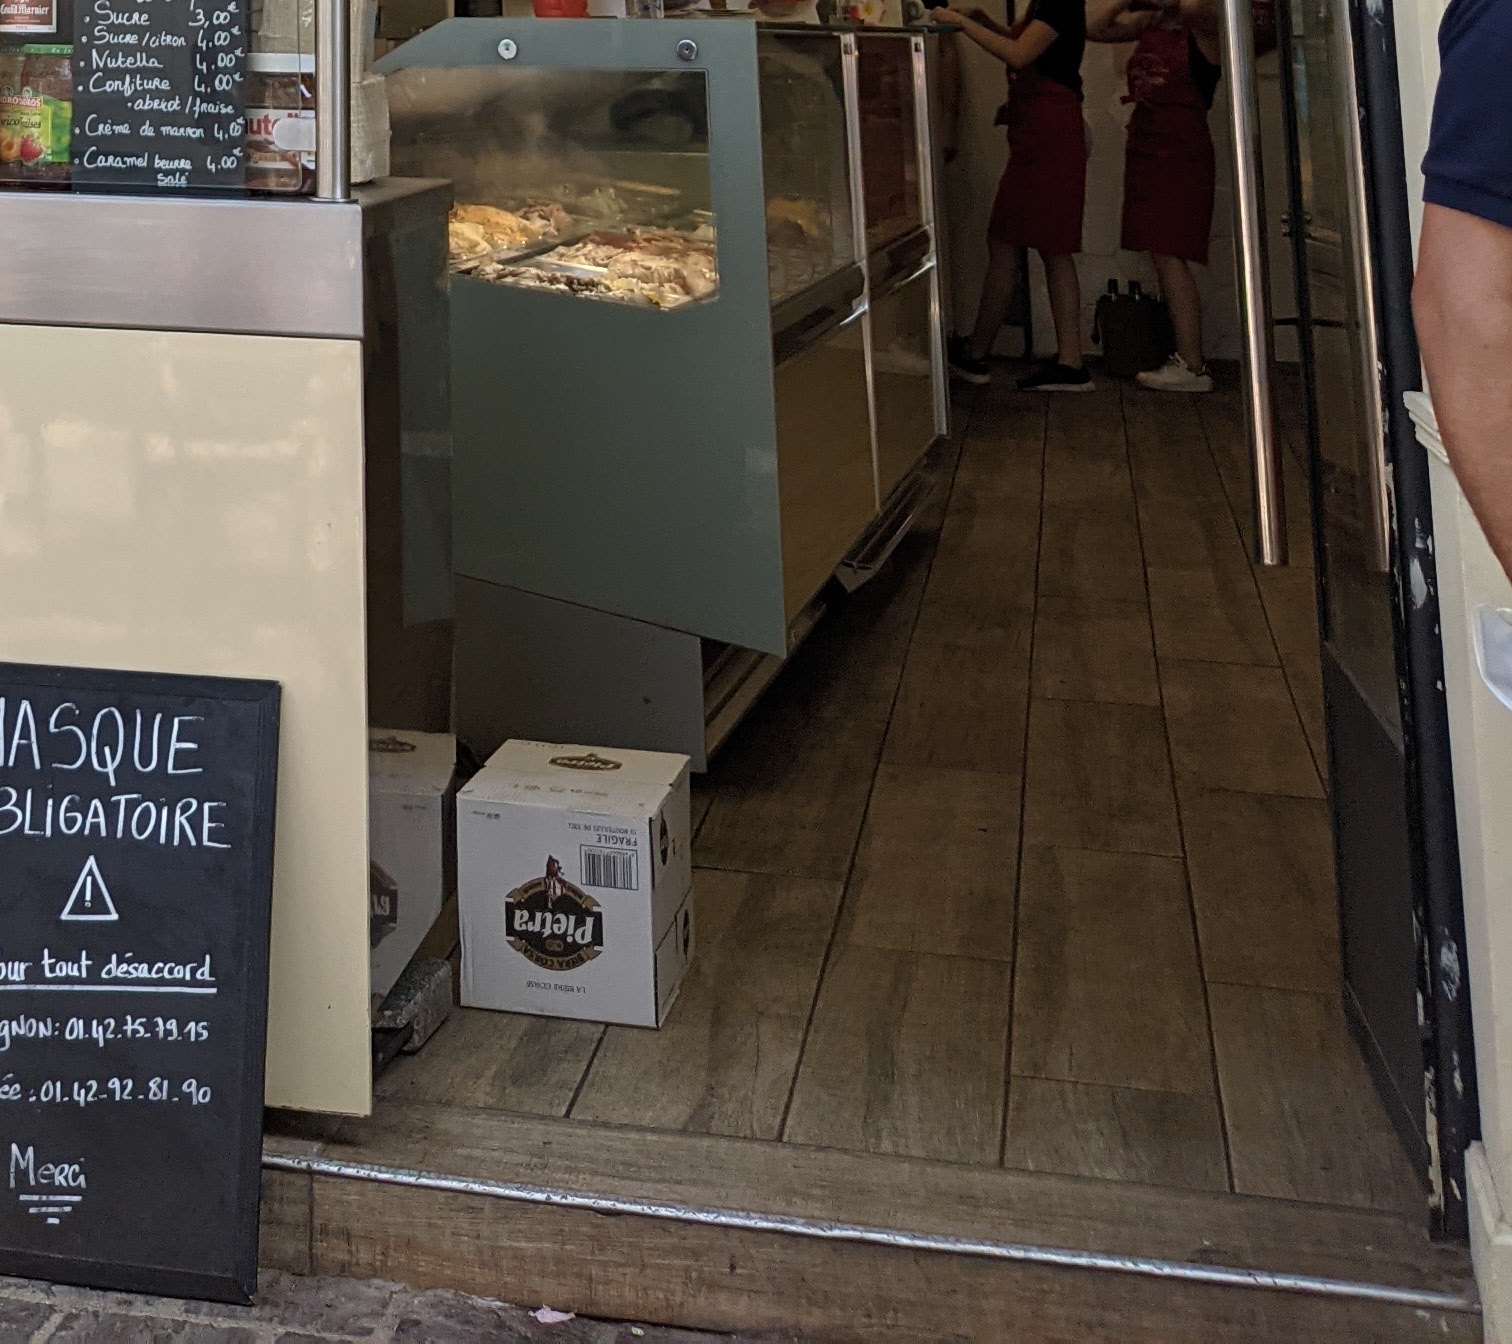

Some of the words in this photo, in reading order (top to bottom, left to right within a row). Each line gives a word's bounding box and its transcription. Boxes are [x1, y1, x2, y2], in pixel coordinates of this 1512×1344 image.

[92, 48, 163, 70] Nutella
[89, 72, 171, 96] Confiture
[140, 120, 155, 136] de
[84, 146, 147, 169] Caramel
[597, 834, 637, 846] FRAGILE
[514, 910, 594, 944] Pietra
[41, 947, 93, 979] tout
[101, 952, 216, 981] désaccord
[10, 1142, 86, 1188] Merci
